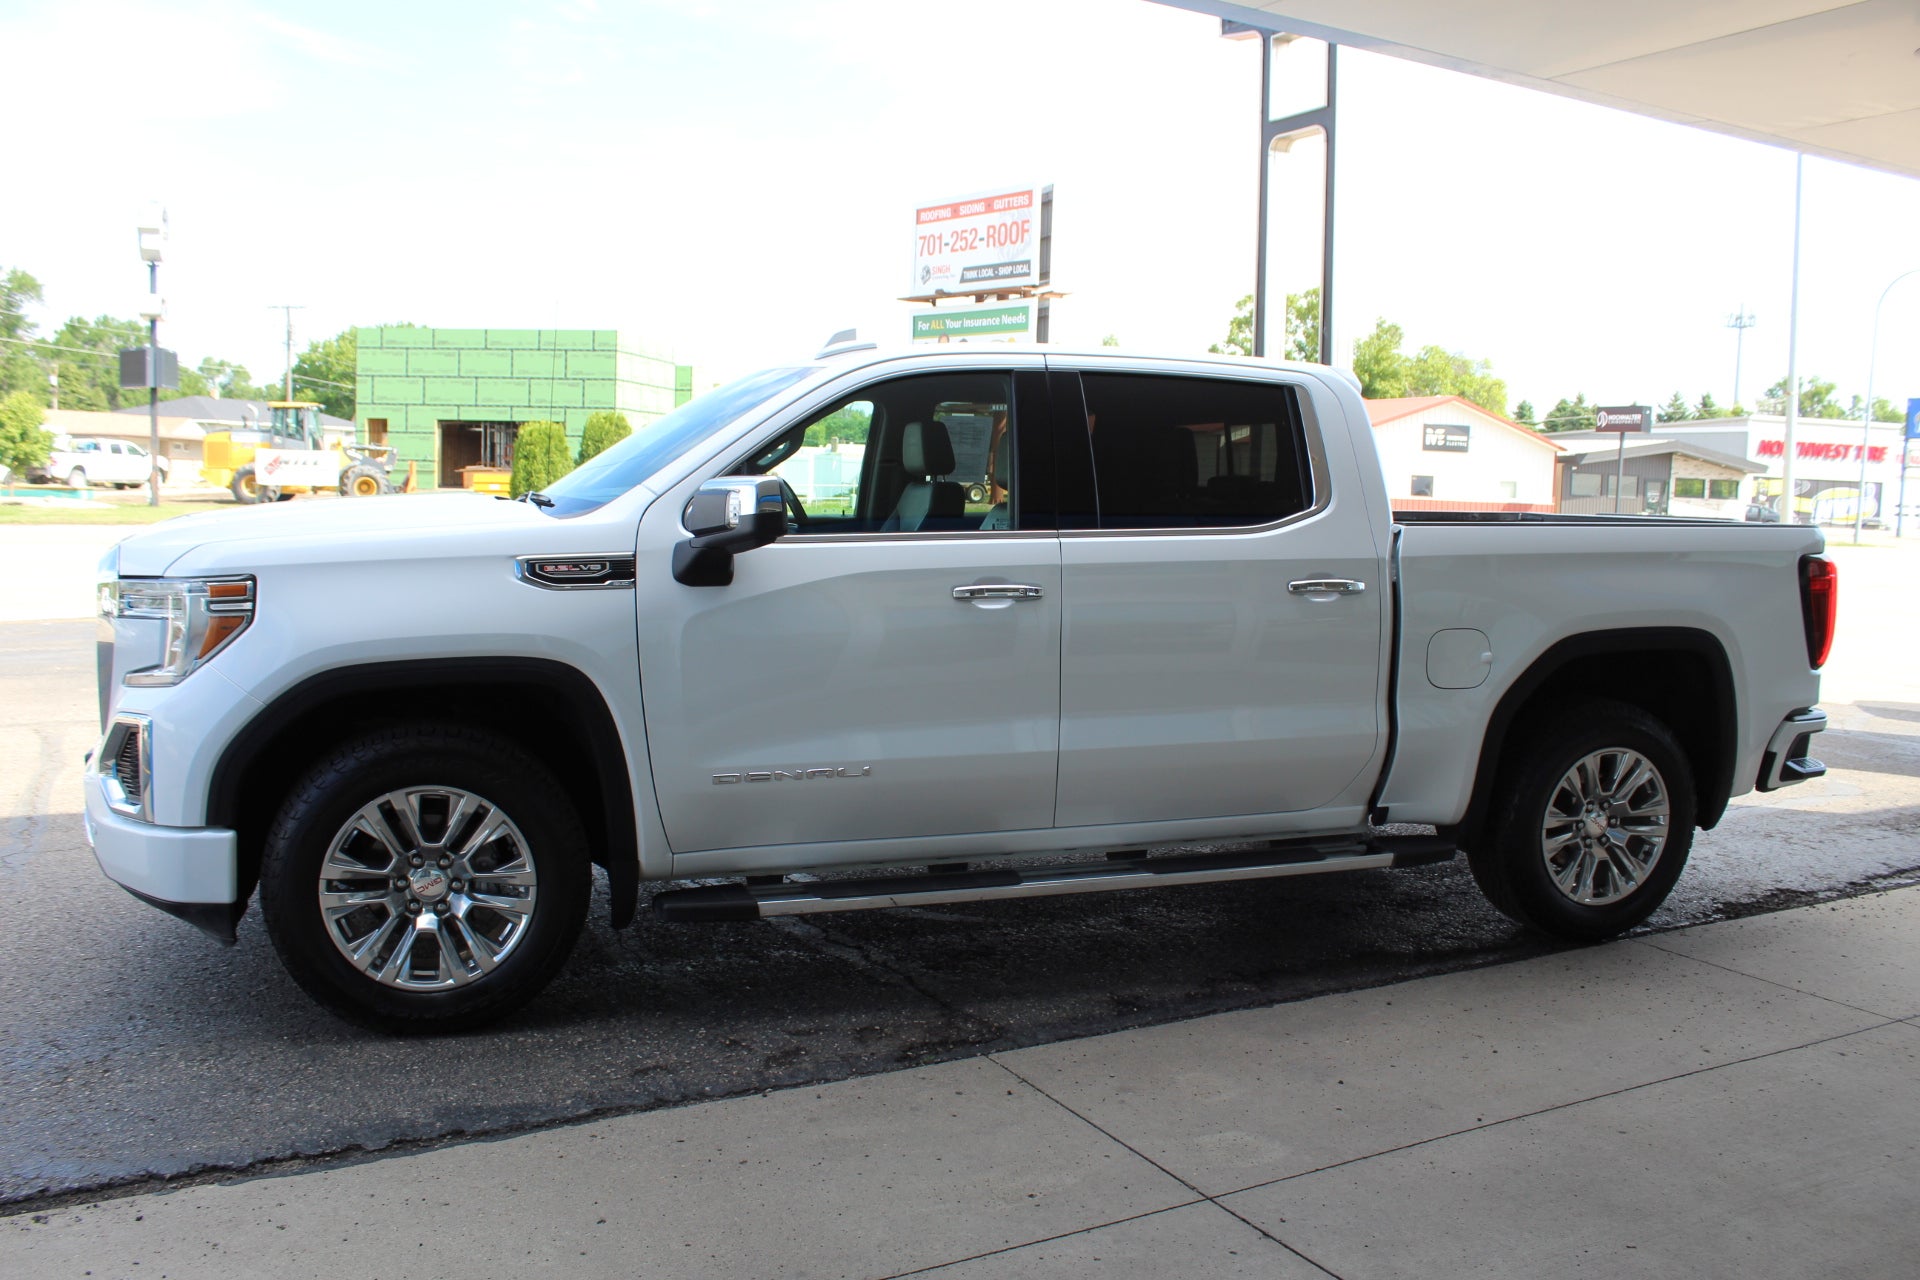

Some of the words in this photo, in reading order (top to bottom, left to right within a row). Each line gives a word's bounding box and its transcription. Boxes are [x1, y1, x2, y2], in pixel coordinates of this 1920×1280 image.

[920, 207, 952, 222] ROOFING
[959, 202, 985, 216] SIDING
[993, 195, 1029, 210] GUTTERS
[918, 219, 1031, 257] 701-252-ROOF
[931, 264, 951, 275] SINGH
[979, 267, 995, 278] LOCAL
[998, 265, 1013, 276] SHOP
[1013, 263, 1030, 274] LOCAL
[917, 320, 929, 331] For
[930, 320, 945, 329] ALL
[945, 318, 962, 329] Your
[963, 316, 1000, 328] Insurance
[1001, 312, 1026, 324] Needs
[1757, 440, 1853, 461] NOHWEST
[1855, 444, 1888, 462] TRE
[712, 766, 871, 785] DENALI
[416, 877, 443, 894] GMC
